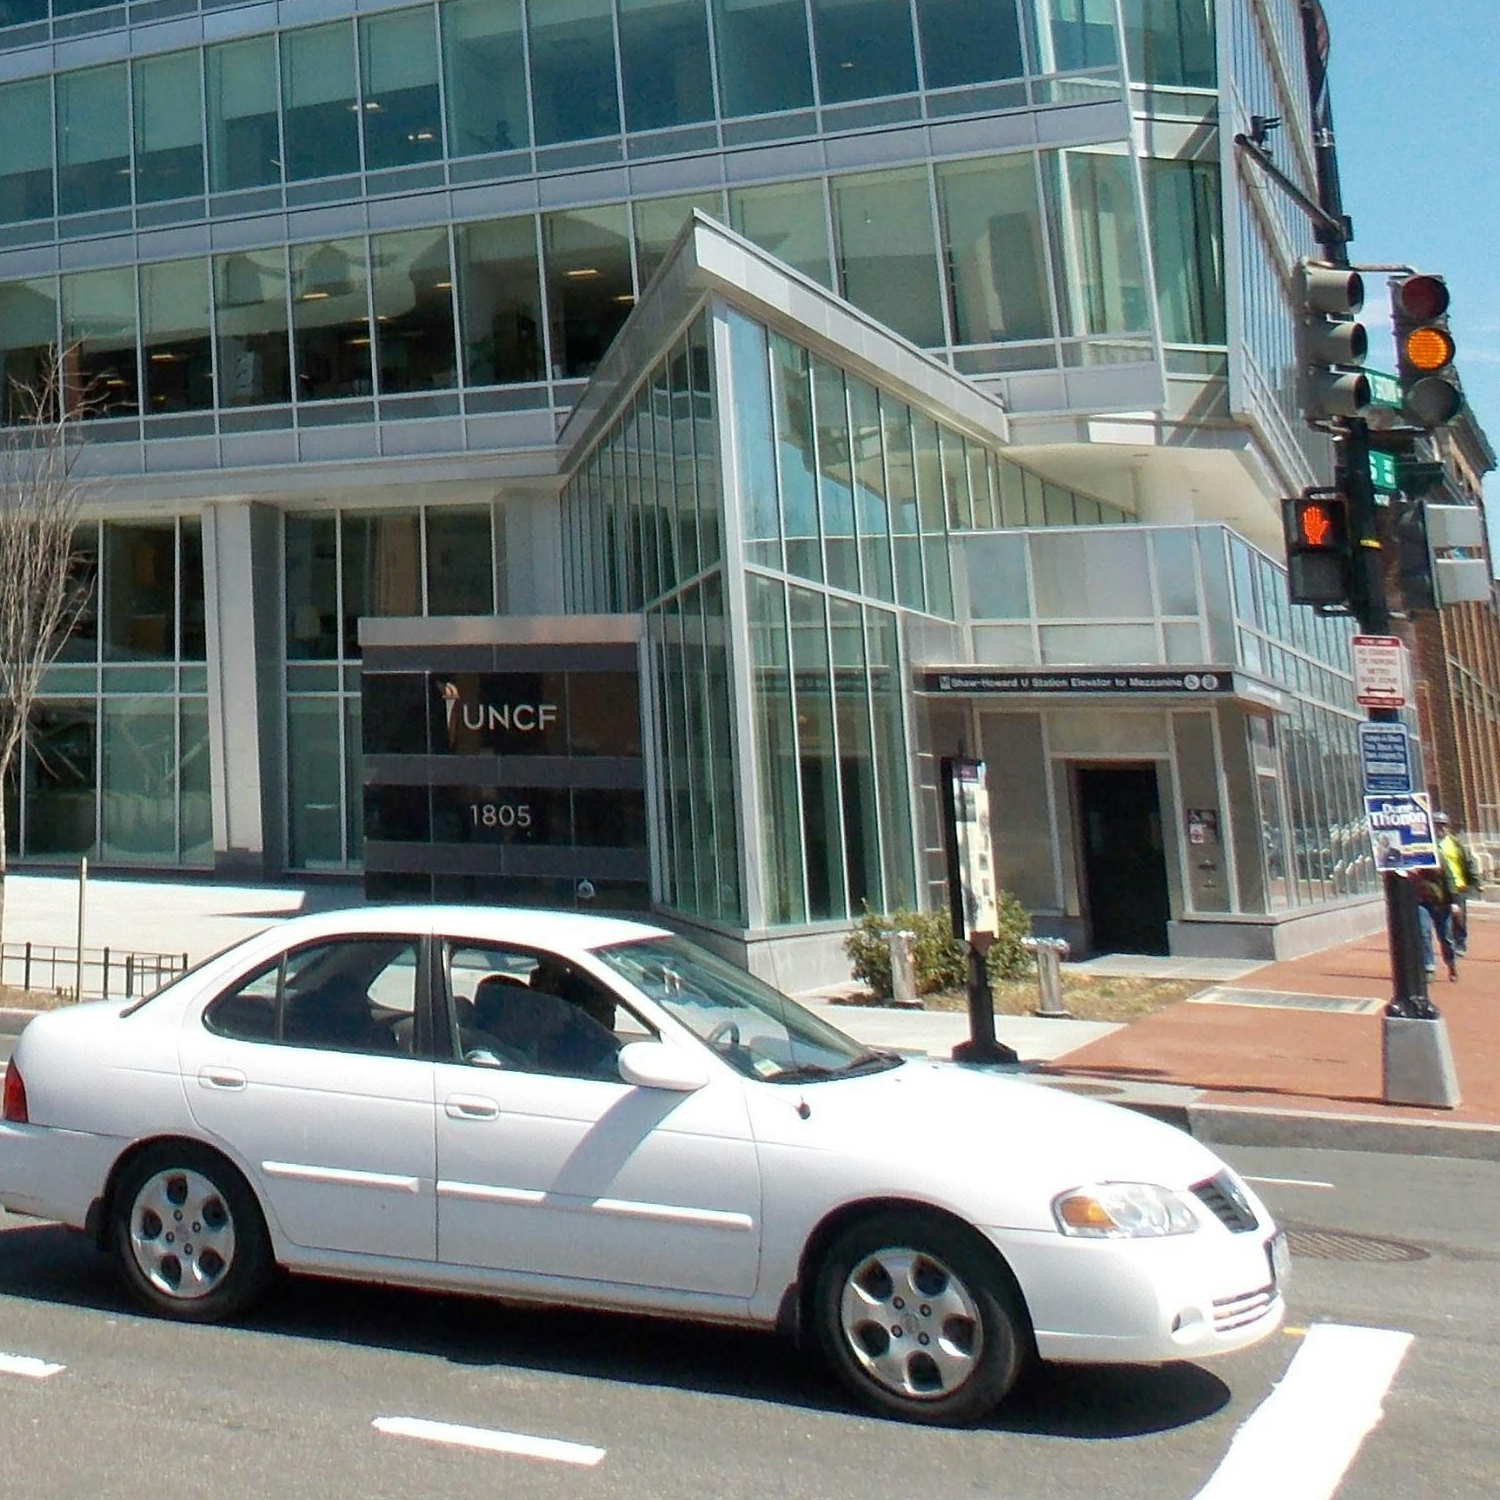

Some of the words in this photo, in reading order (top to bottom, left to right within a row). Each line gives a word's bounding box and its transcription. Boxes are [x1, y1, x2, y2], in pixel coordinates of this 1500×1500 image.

[1021, 678, 1030, 688] U
[1032, 677, 1069, 688] Station
[1070, 677, 1112, 688] Elevator
[1115, 678, 1126, 688] to
[1129, 677, 1183, 688] Mezzanine
[463, 703, 558, 732] UNCF
[470, 804, 532, 827] 1805
